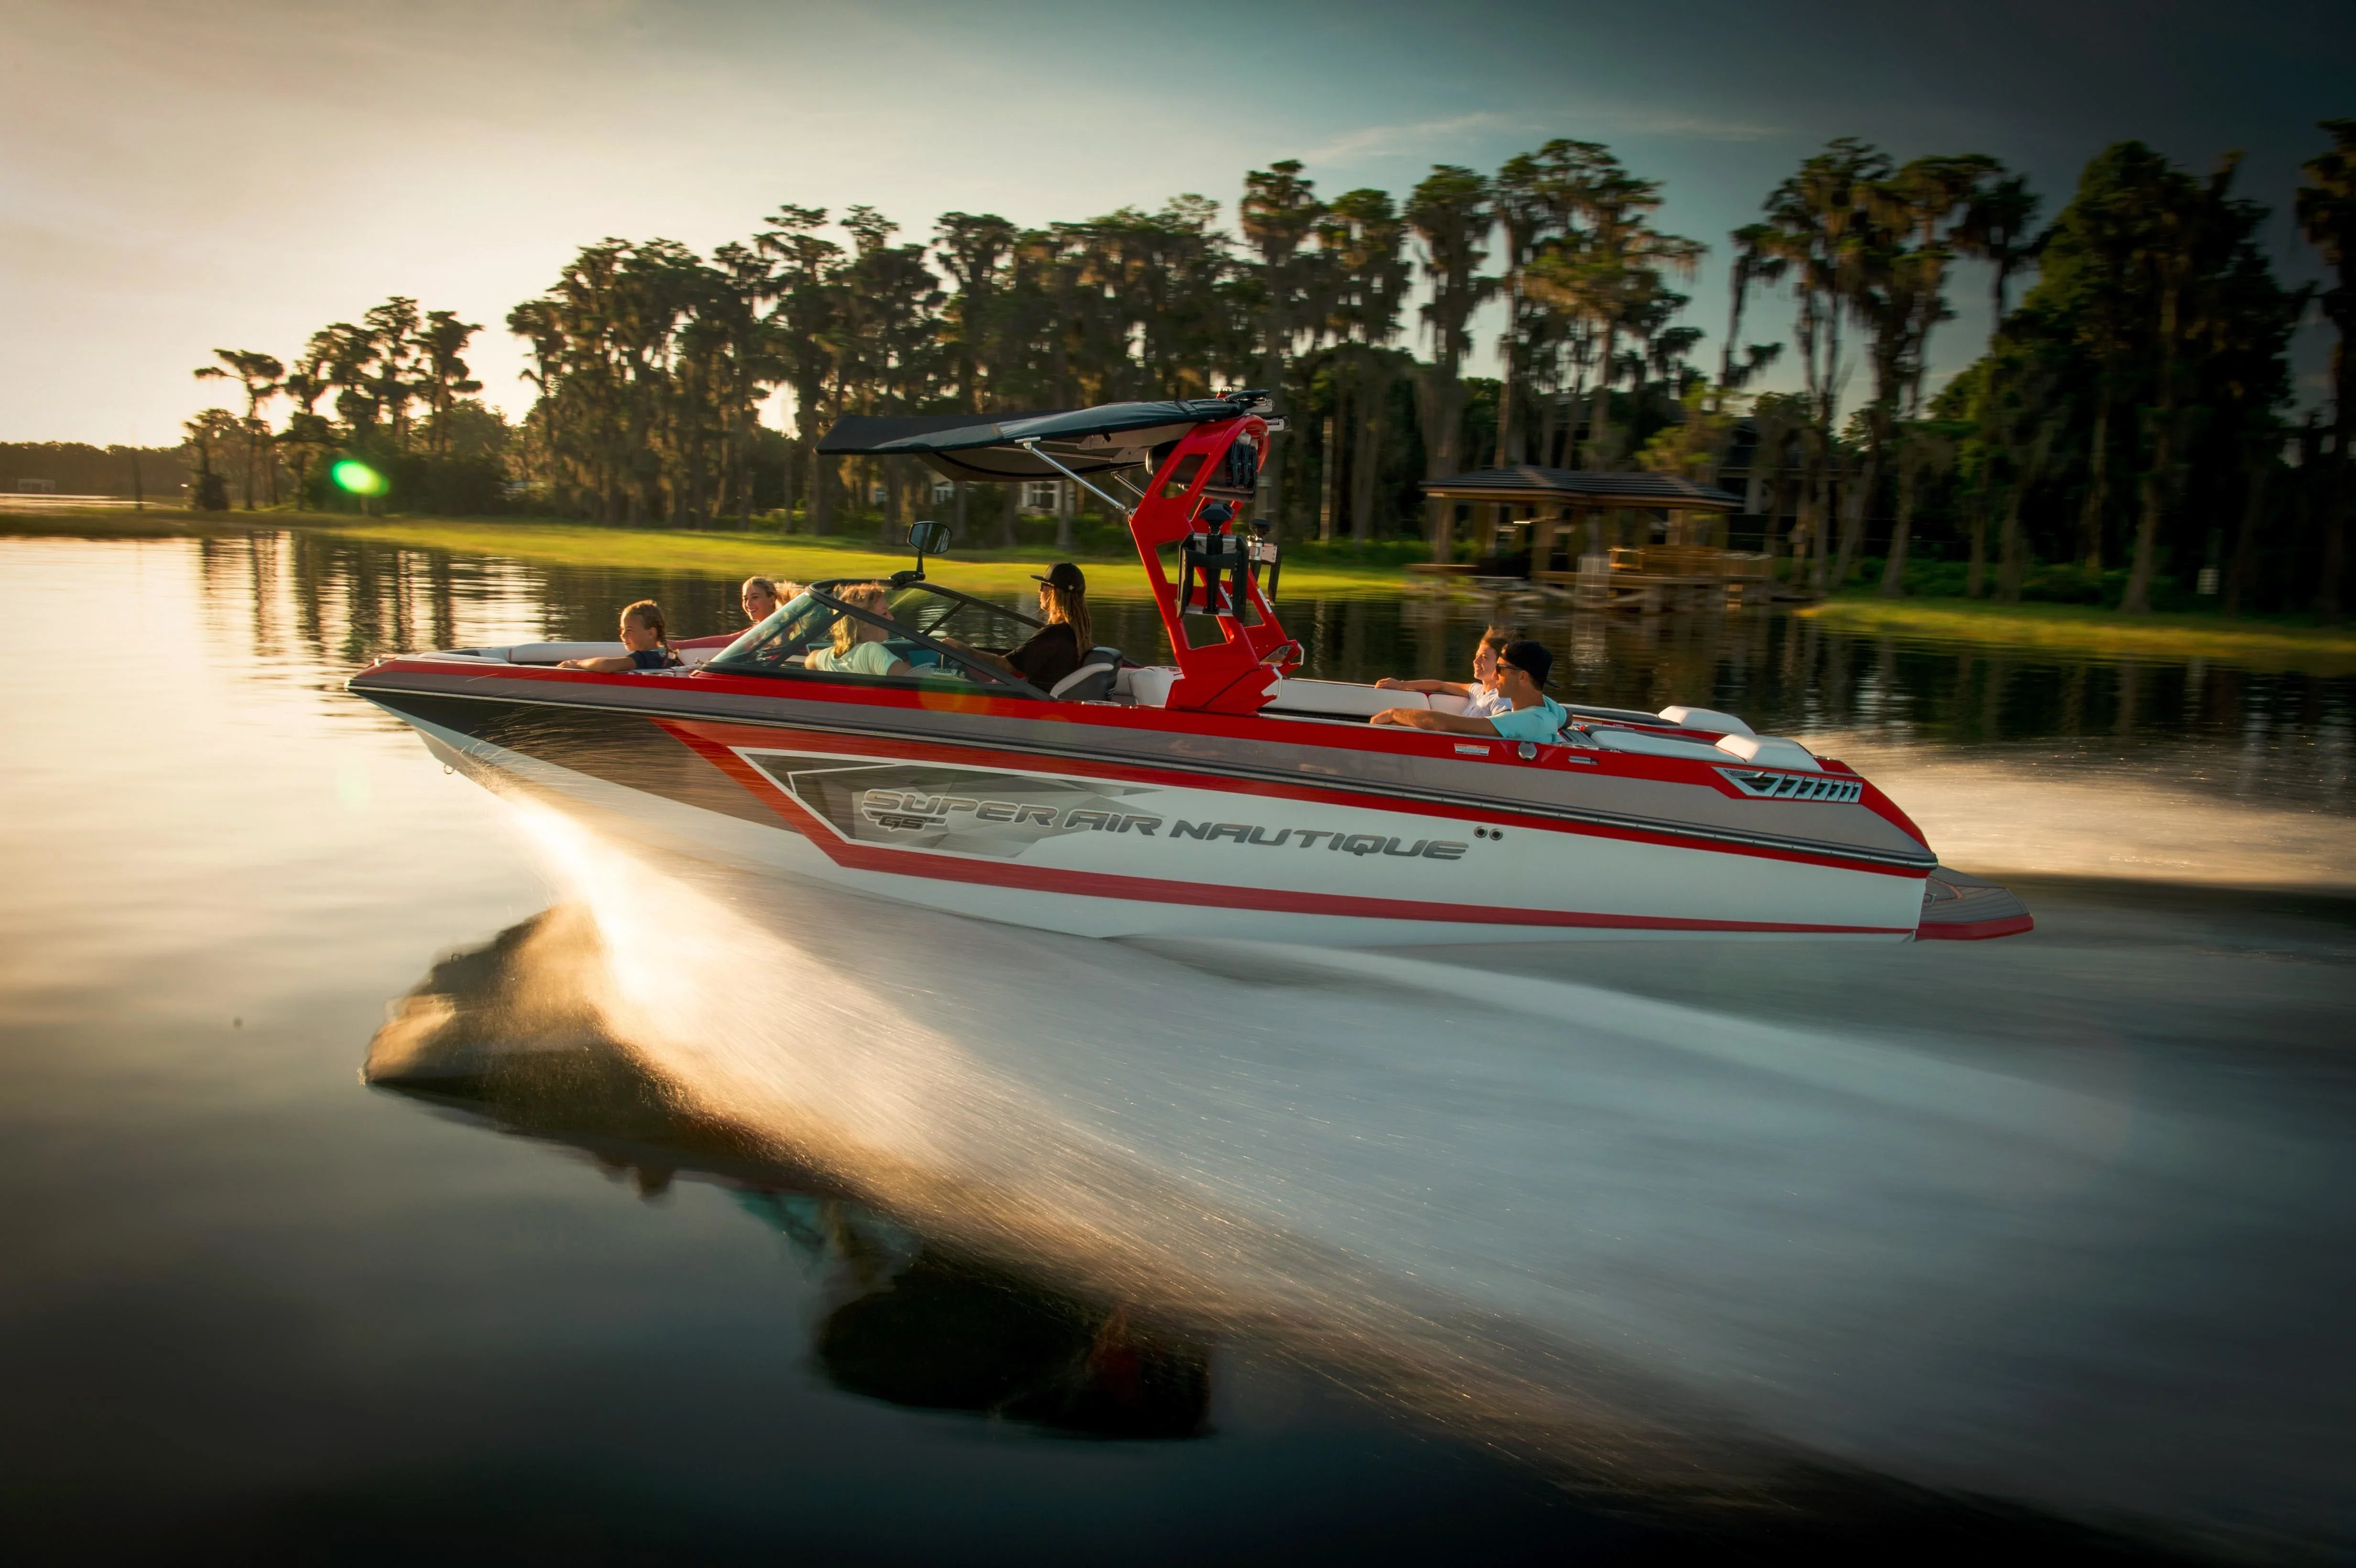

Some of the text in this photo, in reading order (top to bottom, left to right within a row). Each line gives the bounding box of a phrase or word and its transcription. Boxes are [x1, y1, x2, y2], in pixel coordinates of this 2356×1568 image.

[862, 790, 1469, 860] SUPER AIR NAUTIQUE
